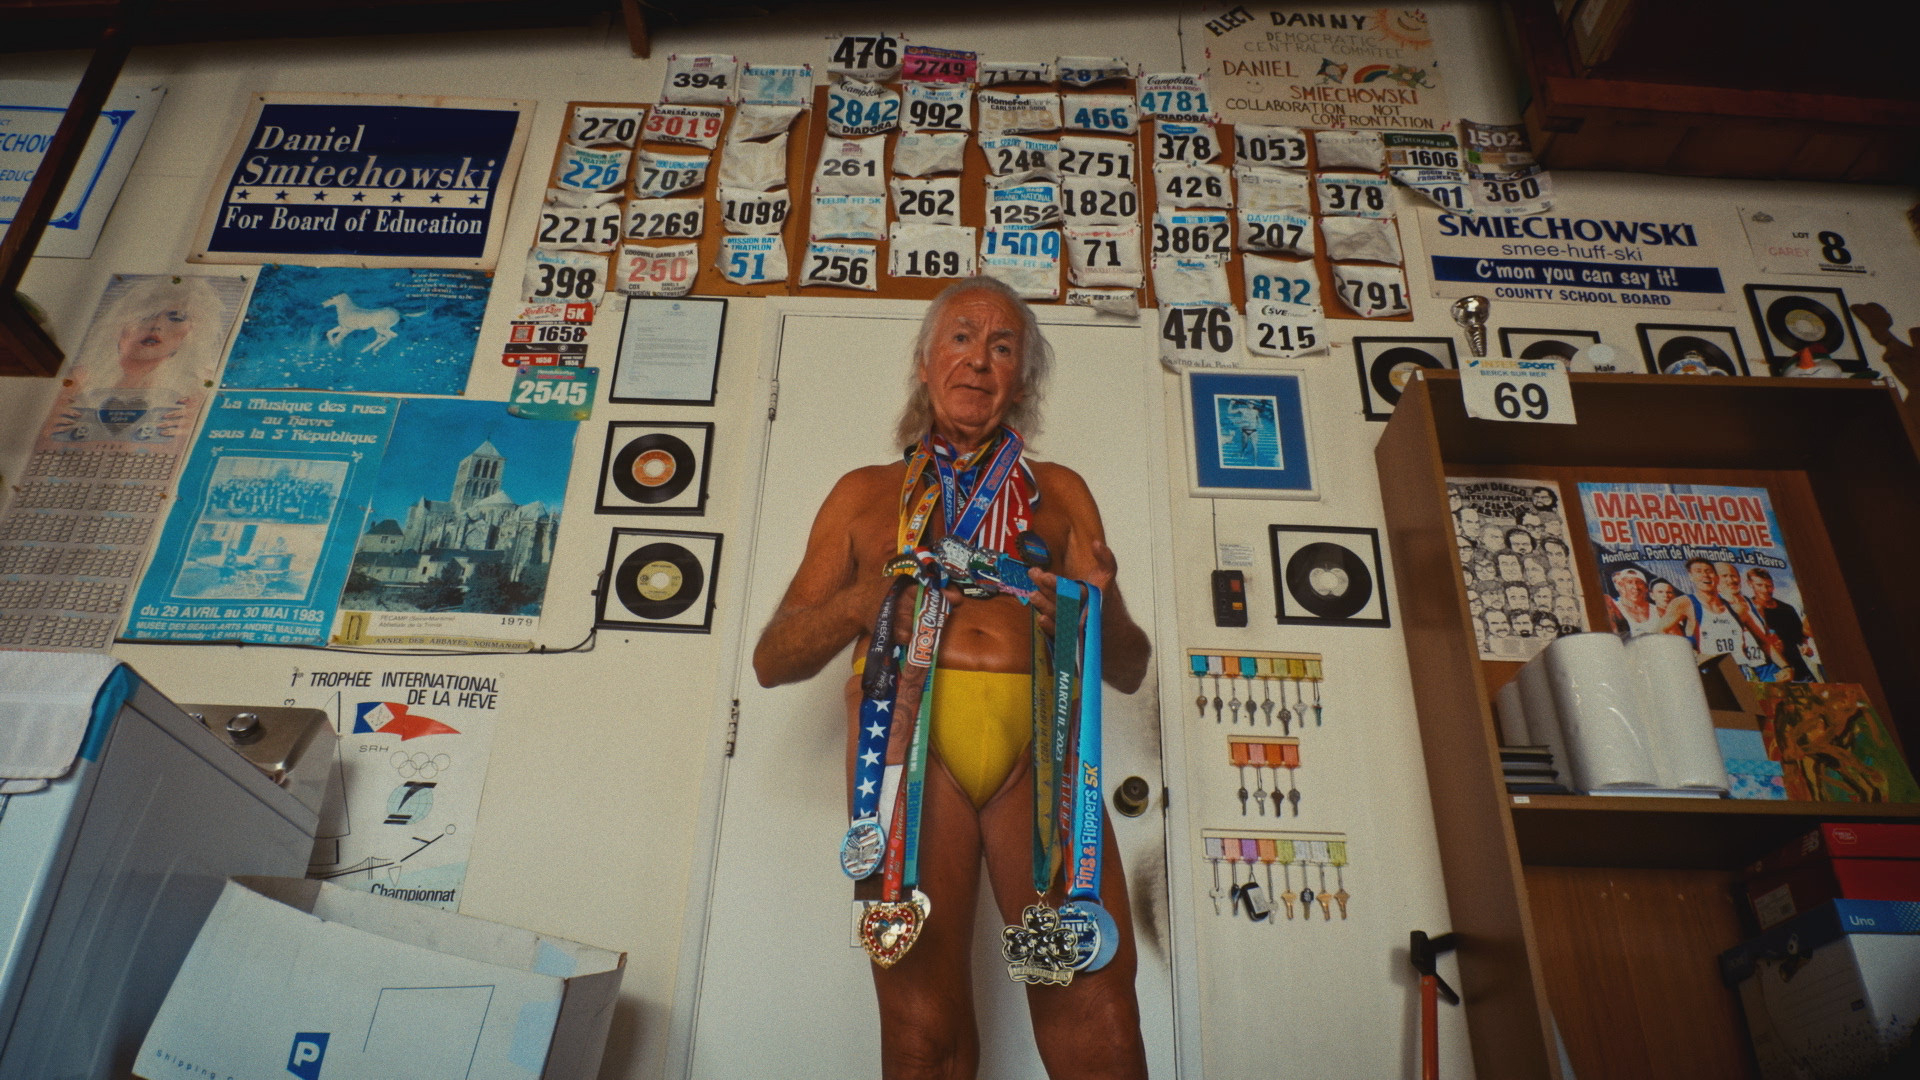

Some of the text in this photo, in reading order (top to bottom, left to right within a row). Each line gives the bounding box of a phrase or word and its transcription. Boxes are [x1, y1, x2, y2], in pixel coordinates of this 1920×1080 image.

[1205, 6, 1256, 37] ELECT
[1270, 11, 1367, 30] DANNY
[1244, 41, 1324, 54] CENTRAL
[1266, 31, 1379, 47] DEMOCRATIC
[833, 36, 897, 69] 476
[914, 60, 965, 76] 2749
[1222, 60, 1299, 77] DANIEL
[673, 73, 728, 90] 394
[1141, 91, 1209, 113] 4781
[1225, 98, 1402, 116] COLLABORATION NOT
[1290, 85, 1419, 105] SMIECHOWSKI
[828, 95, 899, 126] 2842
[910, 101, 963, 128] 992
[1074, 108, 1129, 129] 466
[1157, 114, 1207, 122] DIADORA
[1311, 114, 1435, 129] CONFRONTATION
[255, 124, 365, 152] Daniel
[578, 118, 636, 141] 270
[645, 115, 721, 138] 3019
[842, 121, 895, 134] DIADORA
[1467, 128, 1522, 147] 1502
[1157, 133, 1210, 160] 378
[1236, 135, 1306, 161] 1053
[238, 155, 496, 189] Smiechowski
[823, 159, 876, 177] 261
[998, 149, 1046, 174] 248
[1058, 149, 1131, 179] 2751
[1408, 151, 1458, 168] 1606
[562, 160, 621, 188] 226
[642, 168, 697, 190] 703
[1167, 176, 1222, 198] 426
[1326, 184, 1384, 210] 378
[1483, 177, 1541, 203] 360
[724, 200, 787, 225] 1098
[899, 190, 954, 216] 262
[990, 205, 1060, 224] 1252
[1063, 189, 1136, 217] 1820
[221, 205, 483, 234] For Board of Education
[539, 213, 620, 244] 2215
[628, 211, 700, 237] 2269
[1247, 214, 1280, 223] DAVID
[1438, 214, 1698, 247] SMIECHOWSKI
[1153, 223, 1230, 253] 3862
[1247, 223, 1303, 248] 207
[1818, 230, 1852, 264] 8
[906, 250, 959, 276] 169
[1083, 240, 1121, 267] 71
[1502, 242, 1643, 262] smee-huff-ski
[628, 257, 688, 282] 250
[728, 252, 766, 280] 51
[809, 255, 868, 285] 256
[1476, 259, 1679, 289] C'mon you can say it!
[534, 264, 597, 299] 398
[1495, 287, 1671, 306] COUNTY SCHOOL BOARD
[566, 308, 586, 320] 5K
[538, 326, 585, 343] 1658
[1163, 308, 1234, 352] 476
[1258, 323, 1315, 350] 215
[515, 380, 587, 406] 2545
[1494, 382, 1549, 420] 69
[221, 397, 387, 415] La Musique des rues
[262, 416, 282, 425] au
[208, 427, 378, 445] sous la République
[1466, 483, 1488, 494] SAN
[1592, 491, 1767, 523] MARATHON
[1600, 520, 1774, 548] DE NORMANDIE
[1601, 546, 1786, 569] Honfleur Pont de Normandie Le Havre
[140, 605, 325, 623] du 29 AVRIL au 30 MAI 1983
[500, 617, 533, 627] 1979
[937, 613, 945, 628] RUN
[874, 619, 889, 653] RESCUE
[915, 623, 938, 660] HOT
[1716, 637, 1734, 653] 618
[381, 672, 499, 693] INTERNATIONAL
[407, 690, 450, 706] DE LA
[1055, 670, 1070, 762] MARCH 2023
[359, 745, 389, 753] SRH
[905, 780, 922, 861] INDEPENDENCE
[1076, 762, 1098, 889] Fins & Flippers 5K
[371, 883, 456, 902] Championnat
[1849, 915, 1876, 926] Uno
[293, 1041, 320, 1067] P
